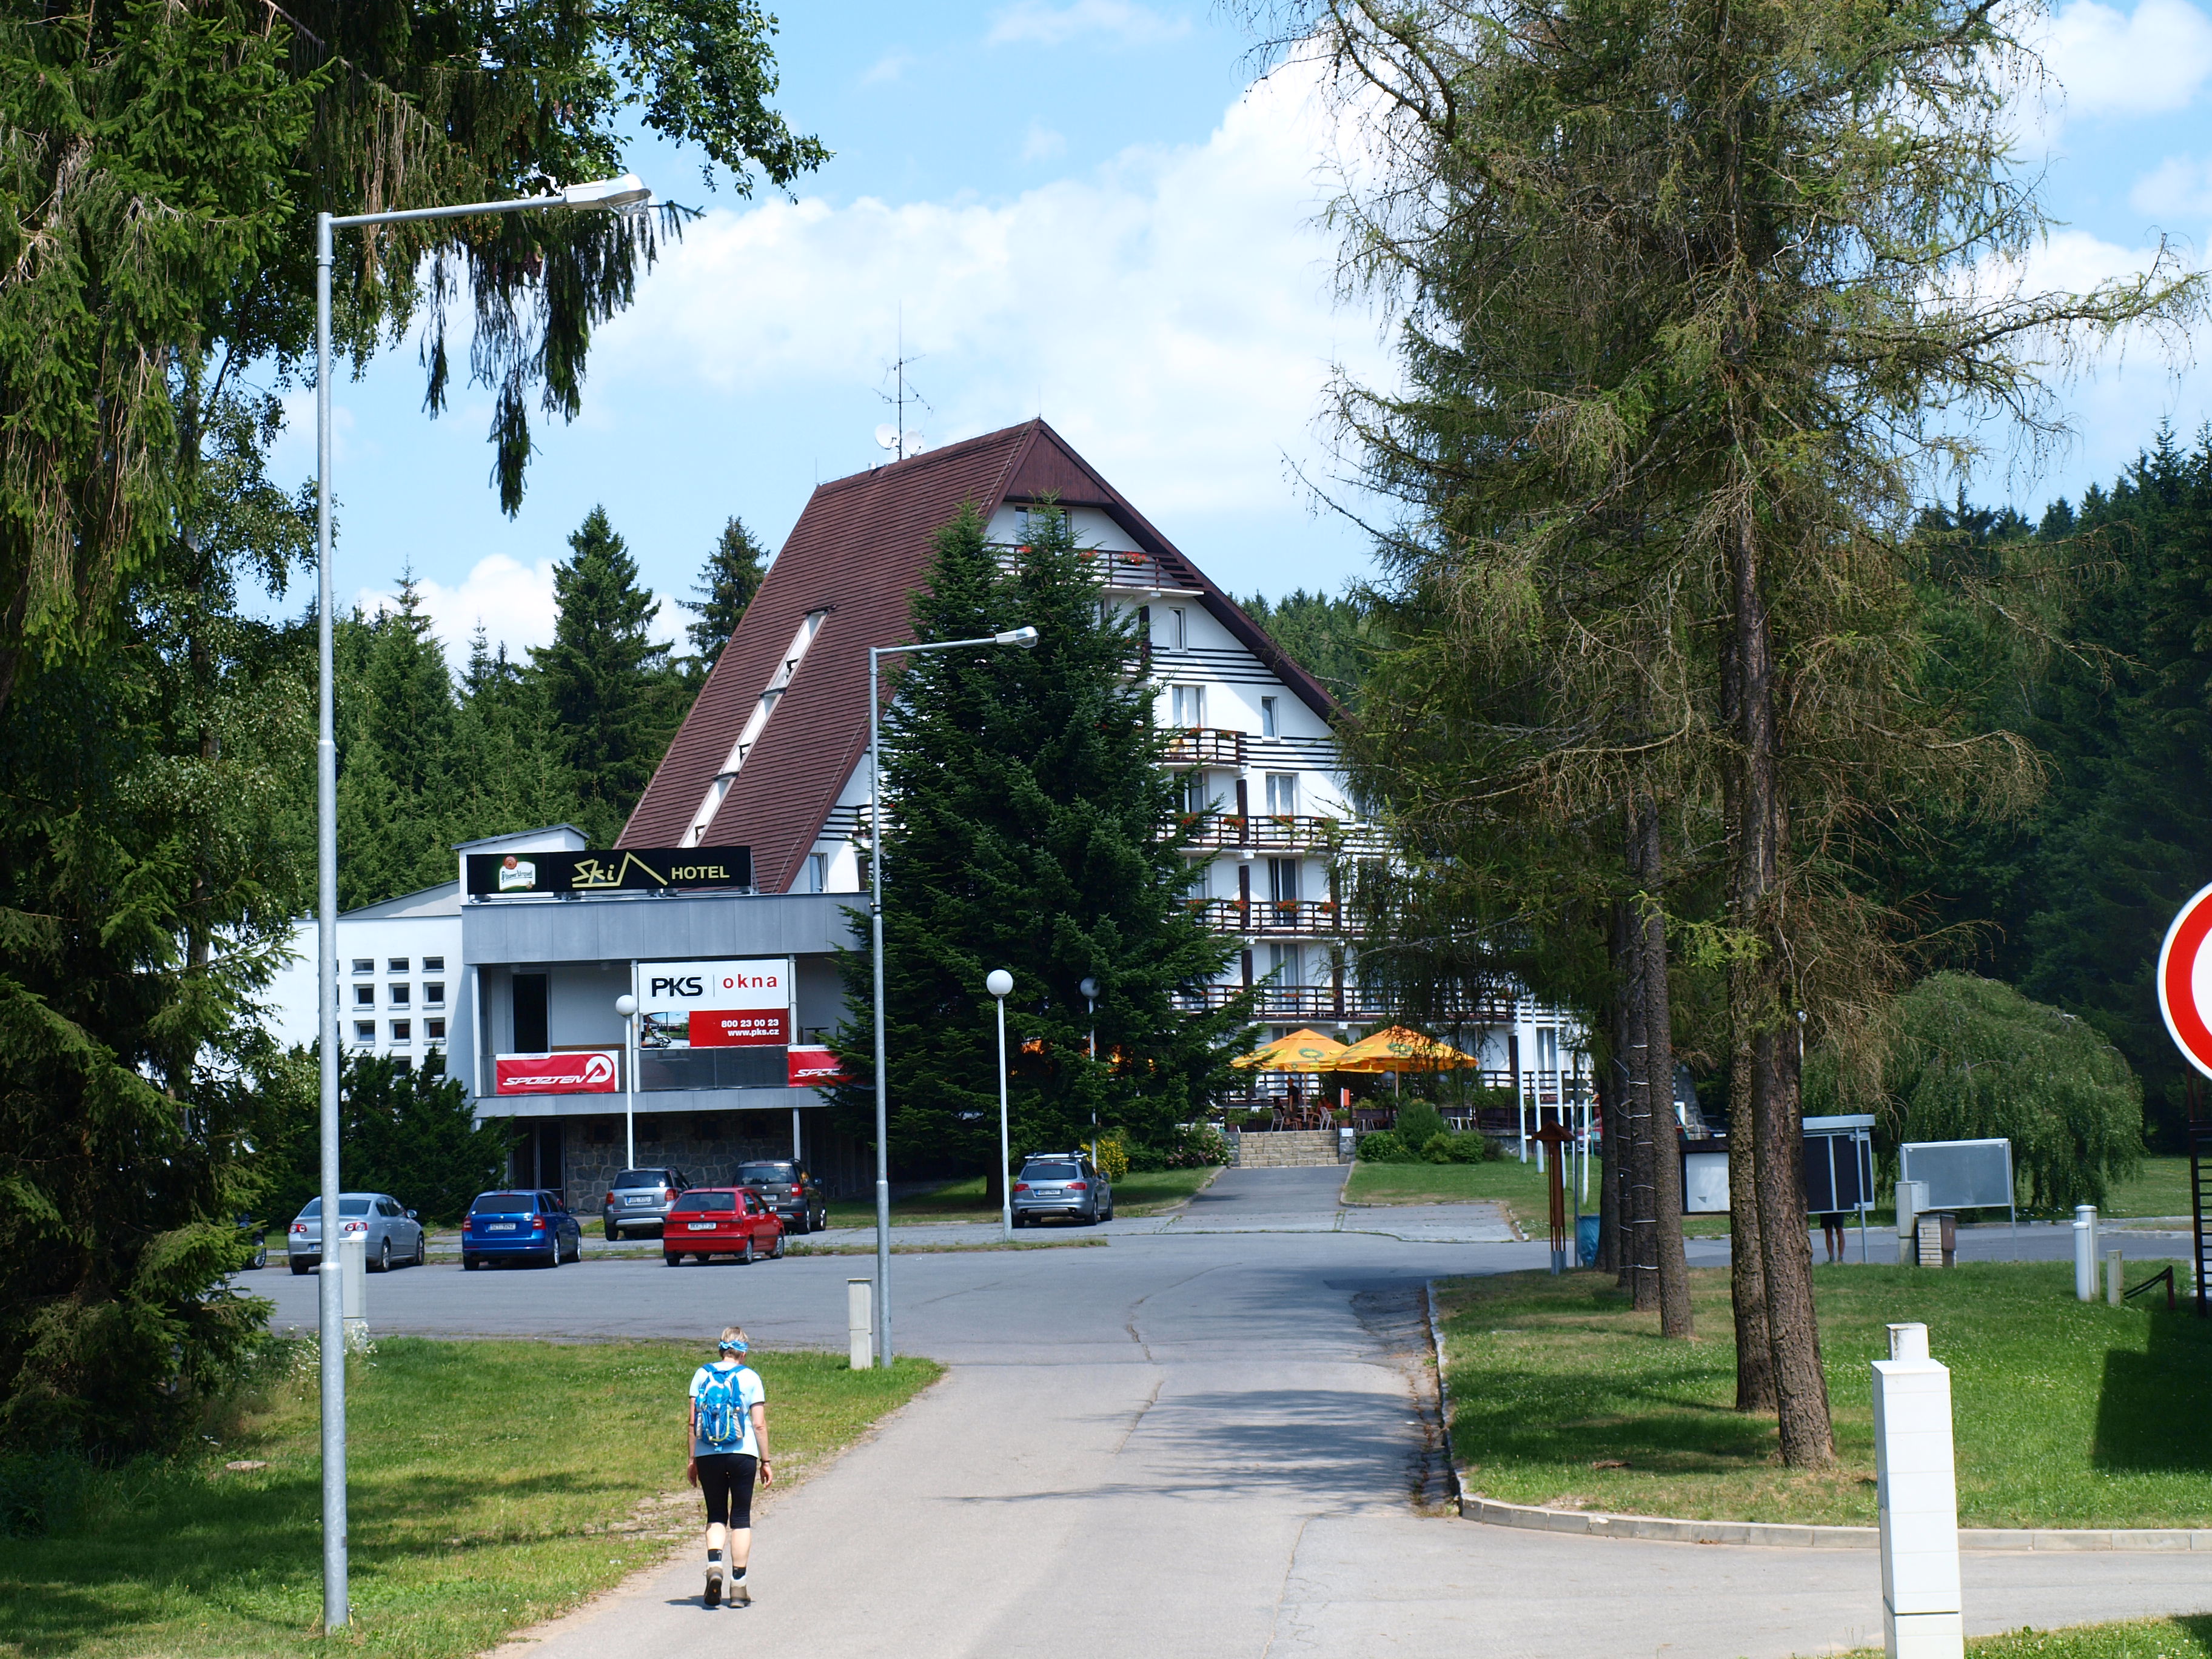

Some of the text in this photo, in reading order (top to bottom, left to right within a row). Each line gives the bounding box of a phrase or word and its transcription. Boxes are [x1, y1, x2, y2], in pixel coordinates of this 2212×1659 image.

[572, 859, 730, 884] Ski HOTEL
[651, 974, 777, 997] PKS okna
[728, 1028, 779, 1037] www.pks.cz
[503, 1075, 587, 1086] SPORTEN
